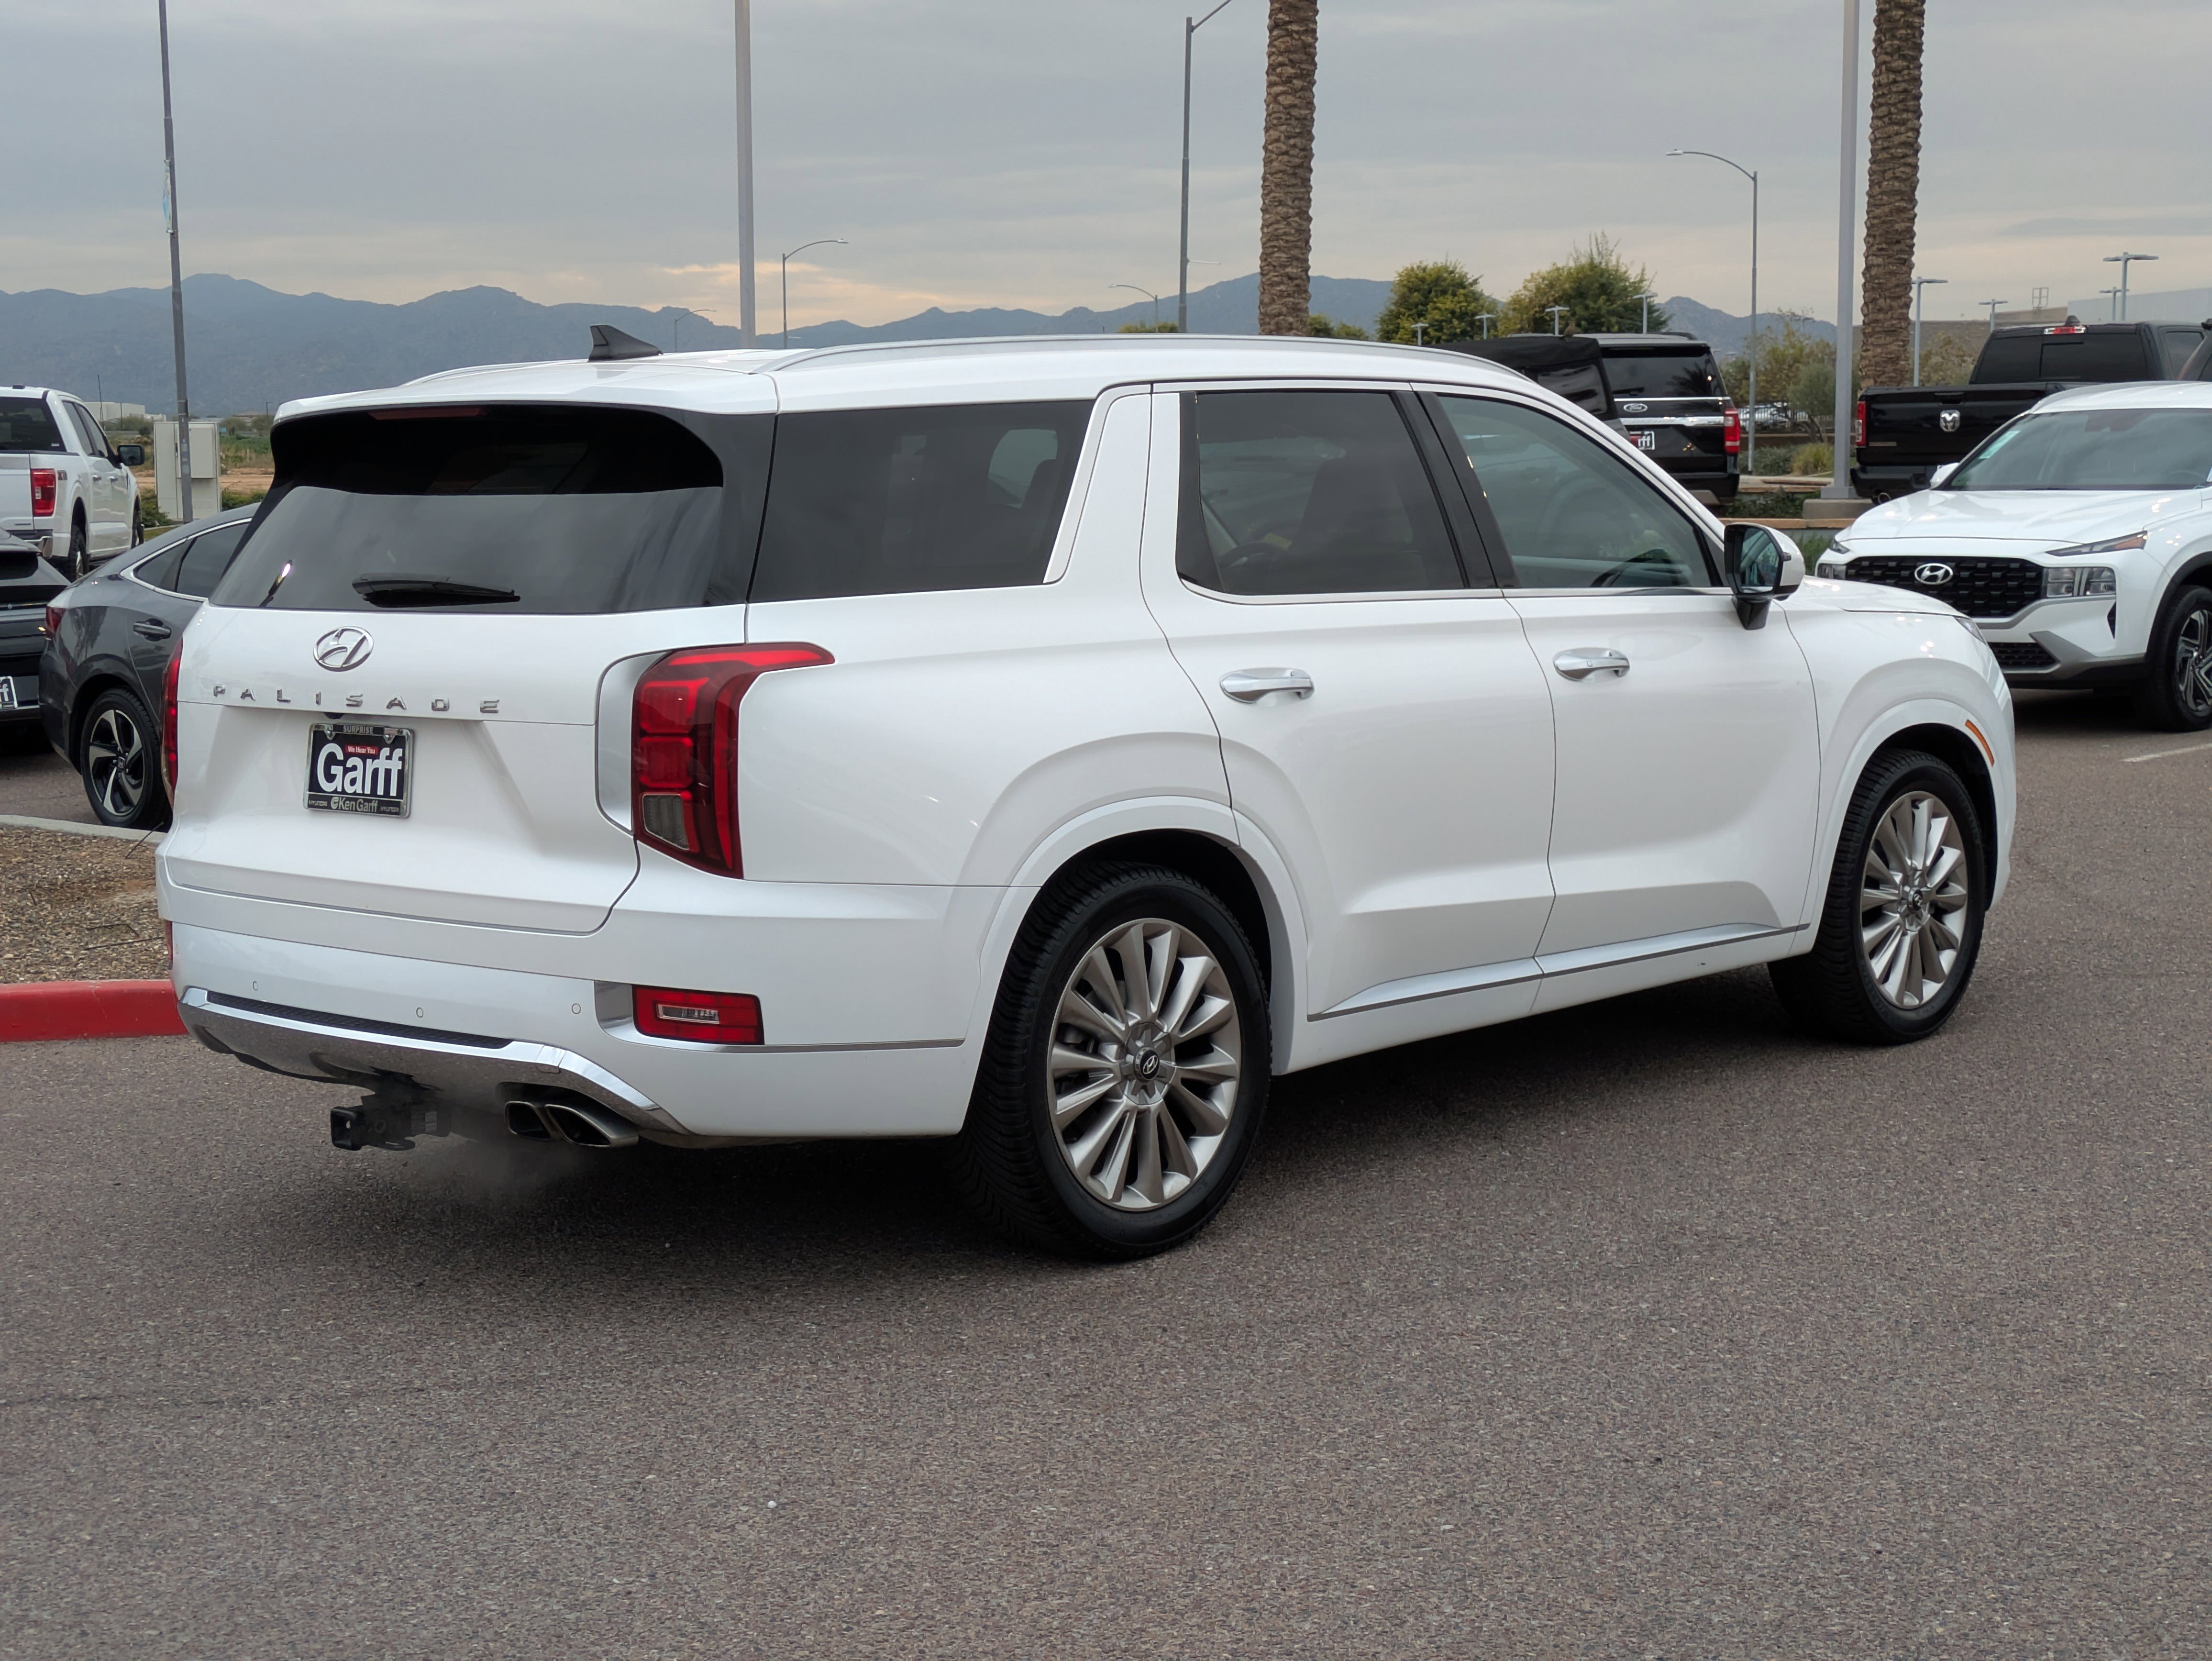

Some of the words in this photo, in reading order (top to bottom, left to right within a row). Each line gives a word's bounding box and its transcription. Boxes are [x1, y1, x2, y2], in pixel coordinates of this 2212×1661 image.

[213, 684, 499, 713] PALISADE
[343, 725, 374, 734] SURPRISE
[317, 743, 403, 797] Garff
[339, 797, 355, 811] Ken
[356, 799, 378, 812] Garff
